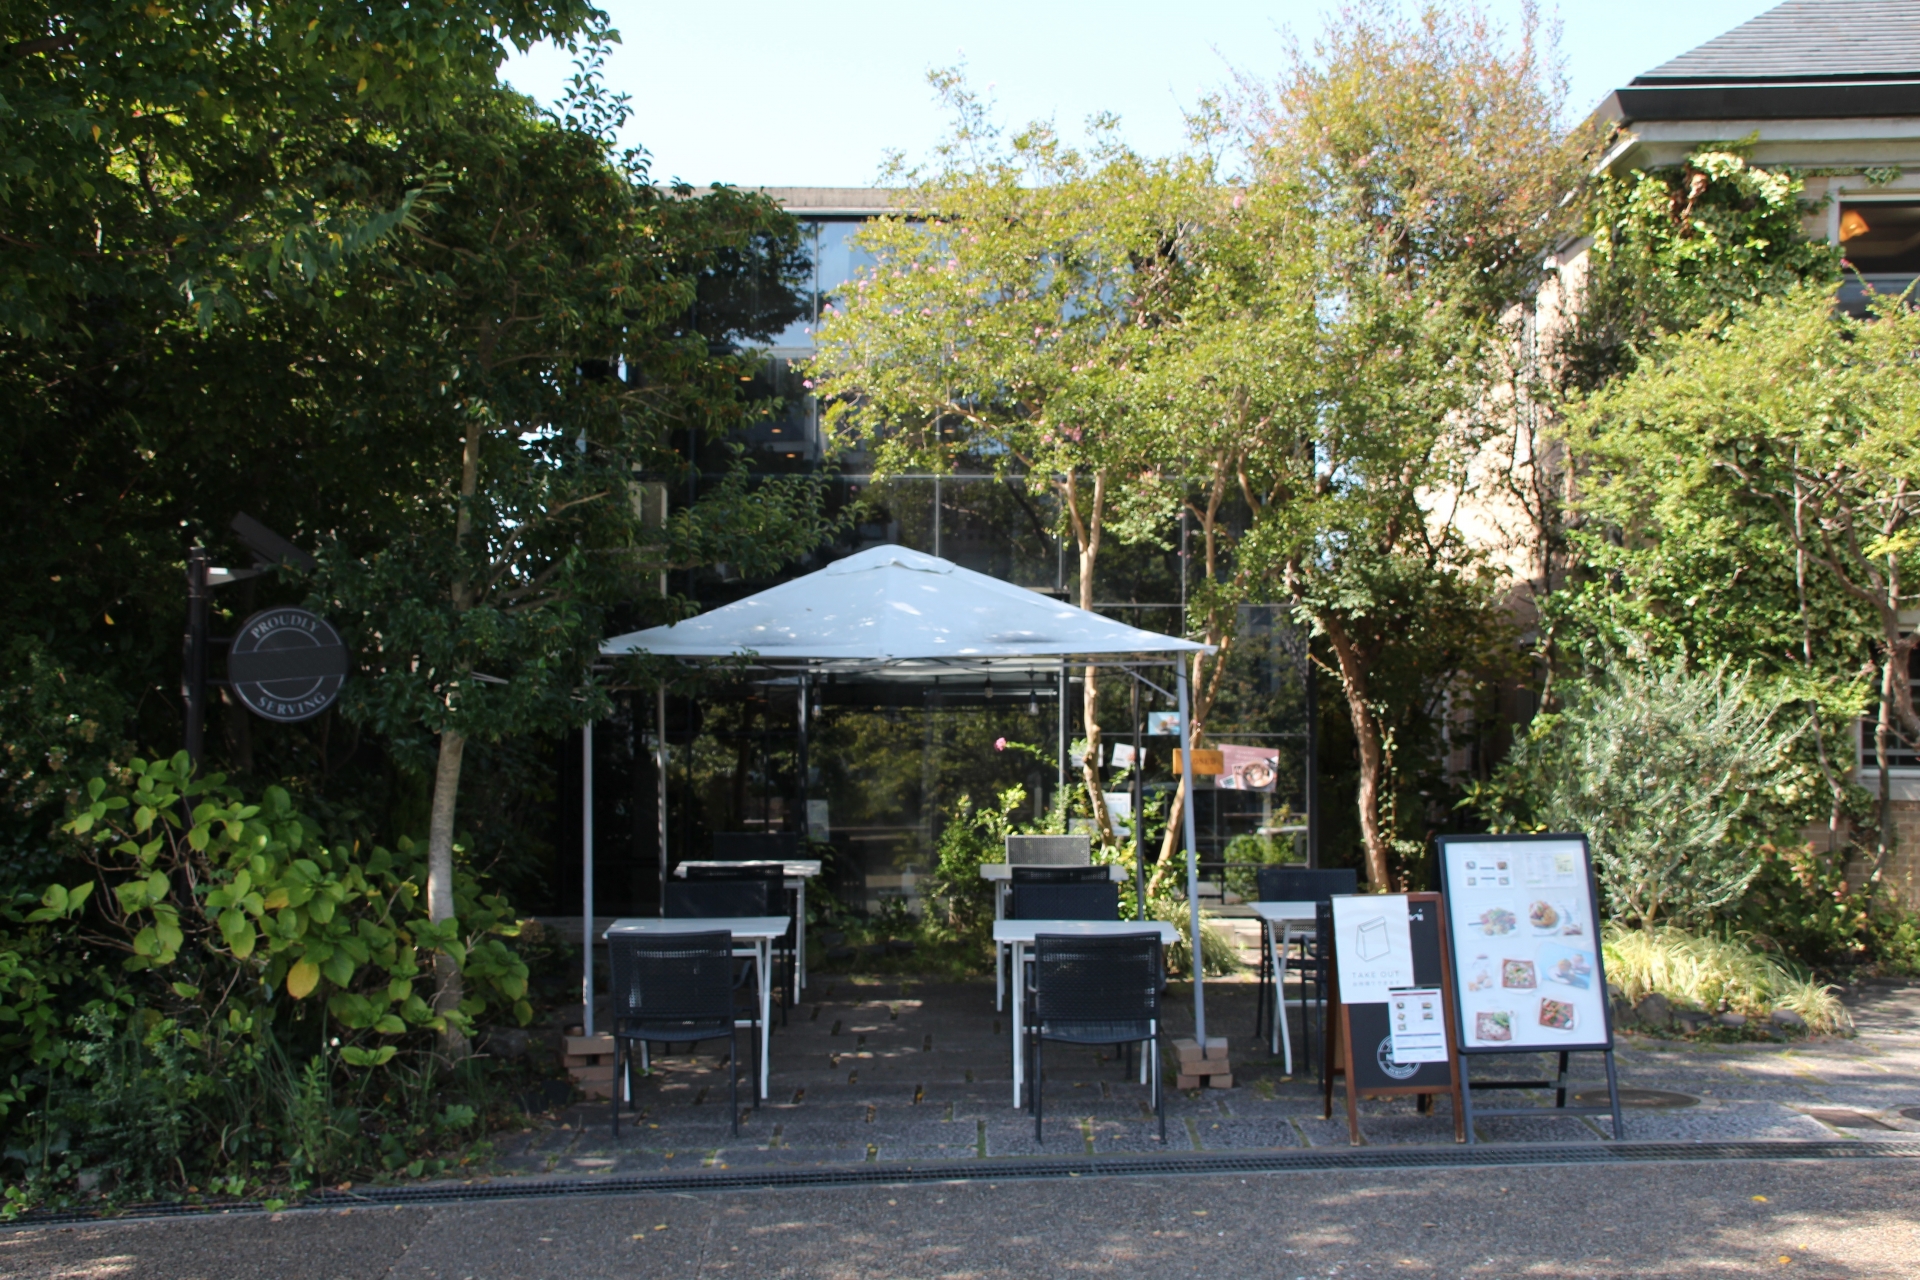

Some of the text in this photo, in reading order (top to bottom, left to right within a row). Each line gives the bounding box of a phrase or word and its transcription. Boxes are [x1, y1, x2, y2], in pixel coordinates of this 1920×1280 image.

[250, 615, 319, 639] PROUDLY
[258, 692, 326, 715] SERVING
[1352, 970, 1400, 979] TAKE OUT
